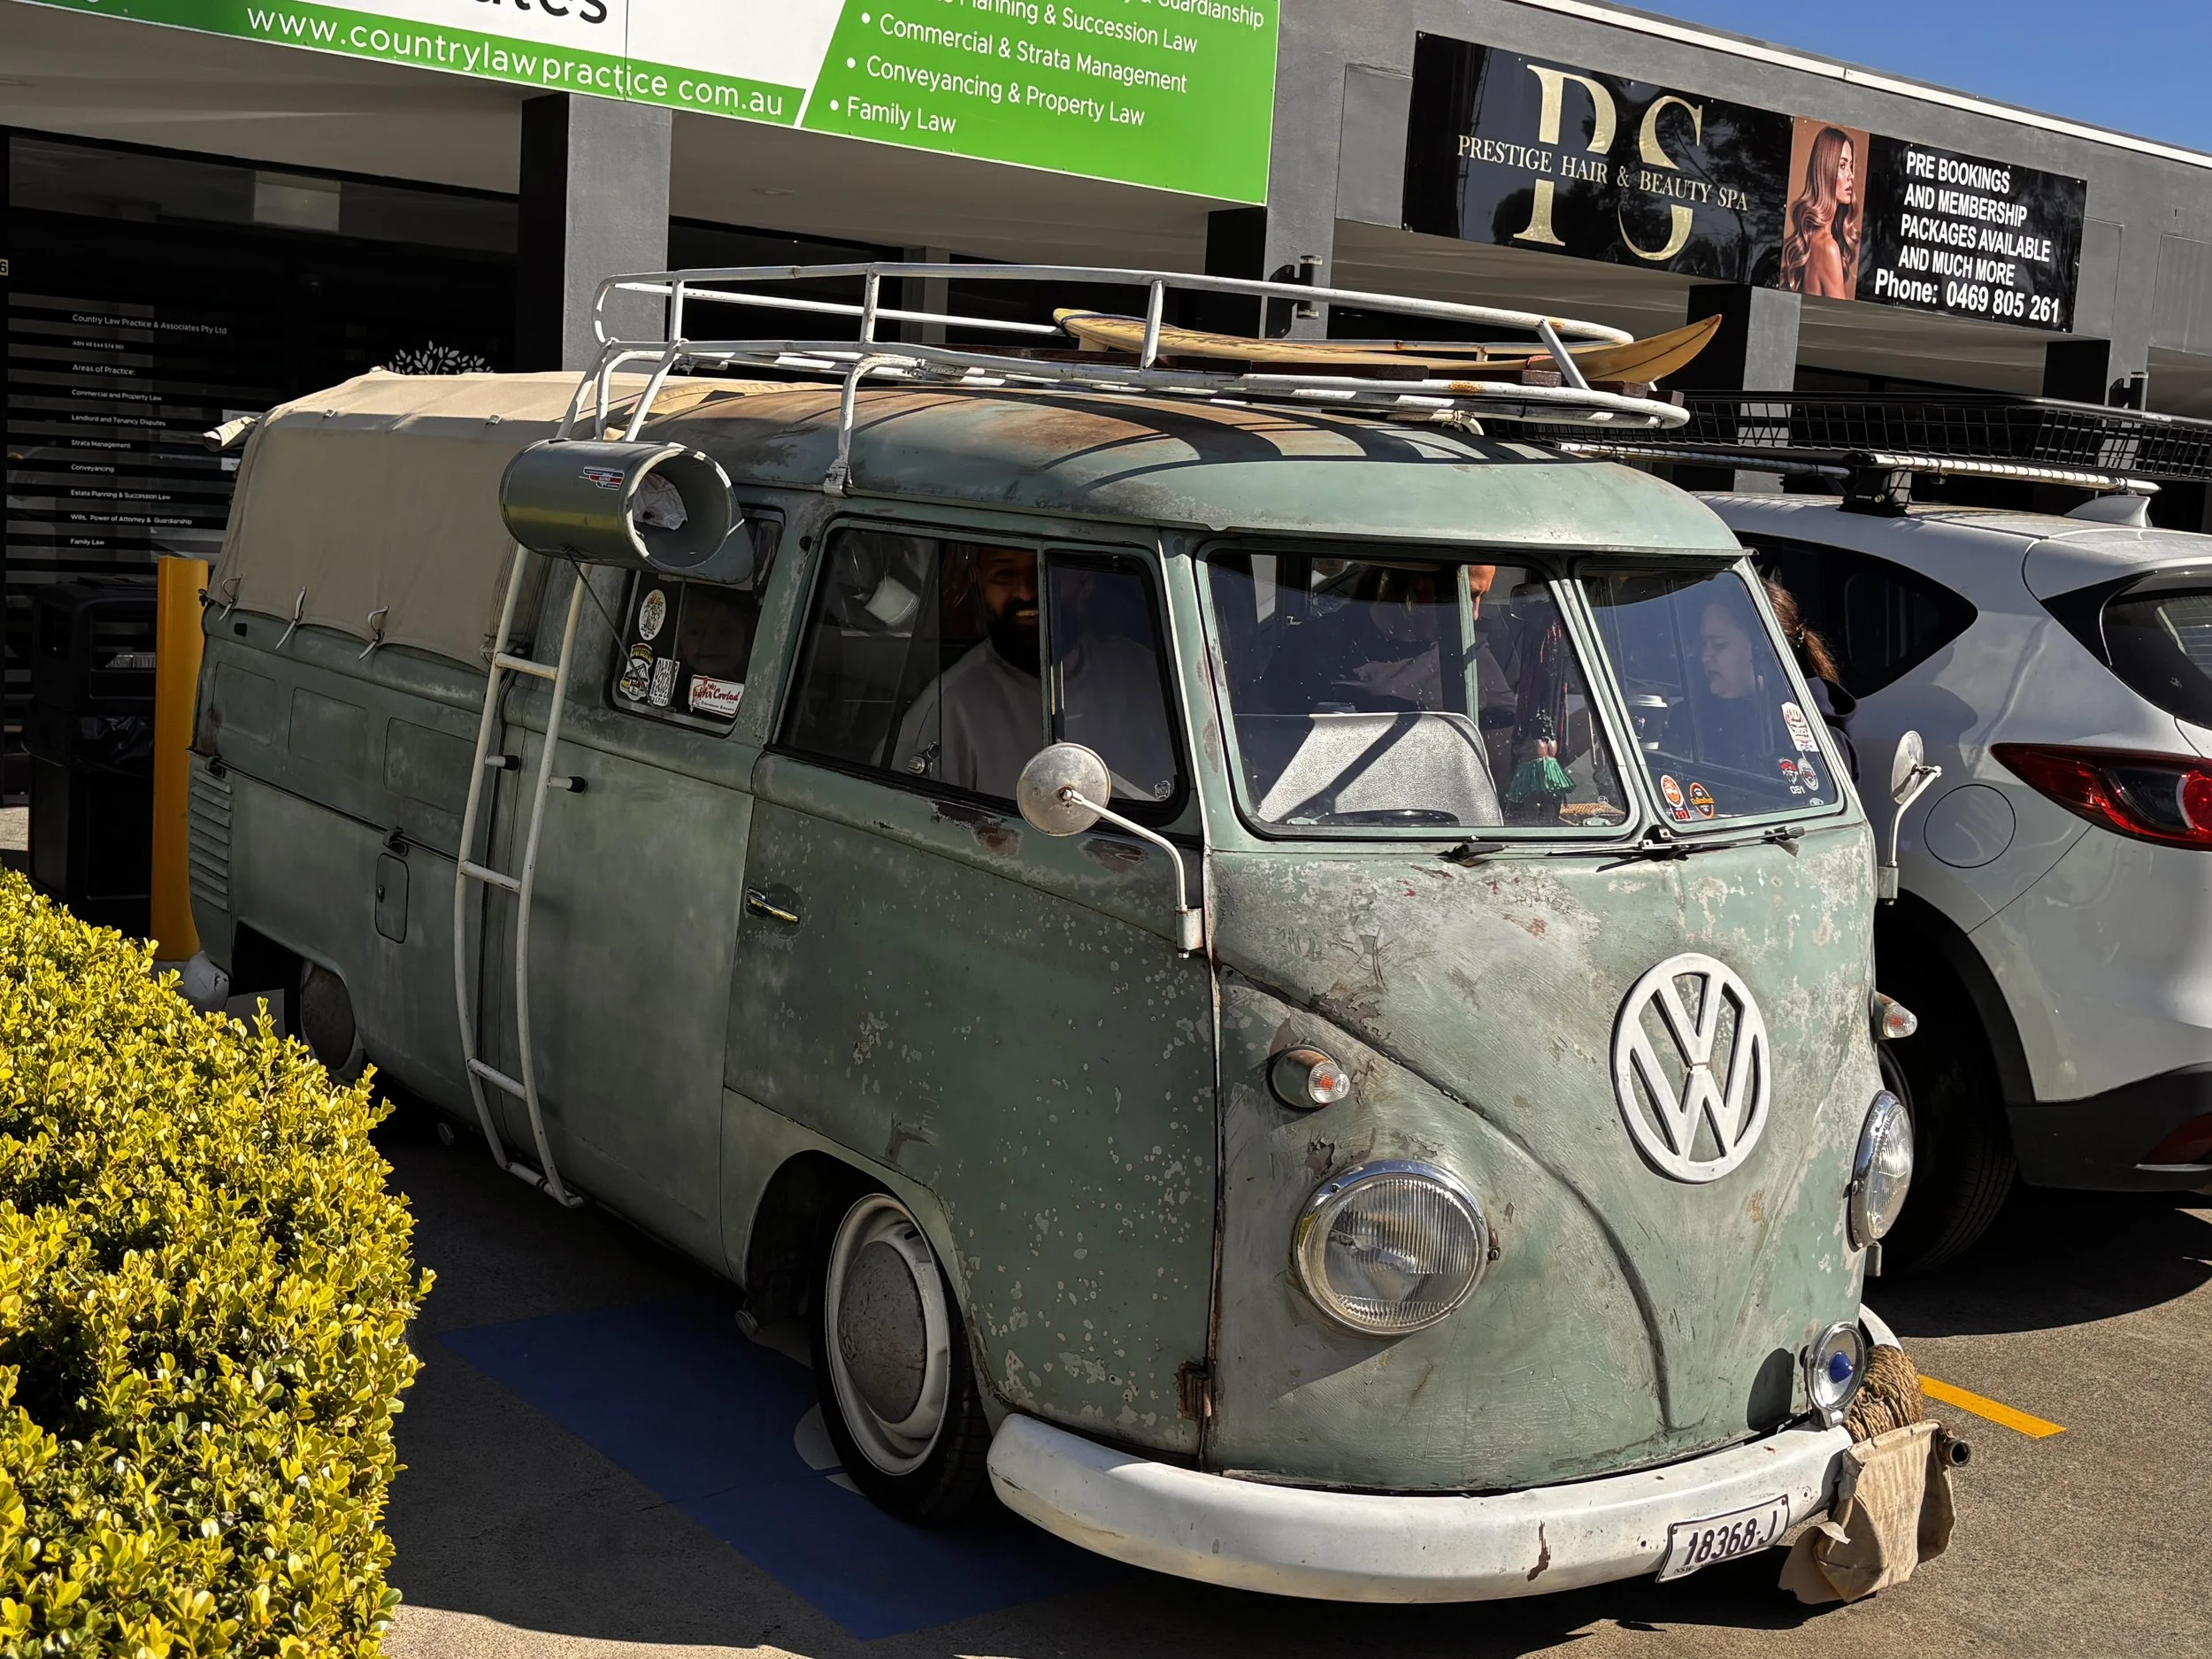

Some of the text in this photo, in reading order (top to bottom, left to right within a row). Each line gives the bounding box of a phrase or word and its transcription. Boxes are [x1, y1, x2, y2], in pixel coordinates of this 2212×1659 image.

[1044, 4, 1056, 25] &
[1062, 7, 1158, 46] Succession
[1163, 28, 1198, 54] Law
[879, 13, 1187, 94] Commercial & Strata Management
[866, 55, 1145, 127] Conveyancing & Property Law
[848, 96, 956, 134] Family Law
[1458, 134, 1748, 211] PRESTIGE HAIR & BEAUTY SPA
[1906, 151, 2010, 194] PRE BOOKINGS
[1904, 183, 2027, 227] AND MEMBERSHIP
[1901, 213, 2051, 262] PACKAGES AVAILABLE
[1898, 245, 2016, 286] AND MUCH MORE
[1875, 268, 2060, 324] Phone: 0469 805 261
[73, 314, 103, 325] Country
[121, 319, 151, 328] Practice
[160, 322, 199, 333] Associates
[201, 325, 213, 334] Pty
[73, 364, 94, 373] Areas
[121, 393, 149, 402] Property
[72, 414, 99, 423] Landlord
[112, 417, 138, 426] Tenancy
[71, 464, 115, 472] Conveyancing
[91, 490, 118, 499] Planning
